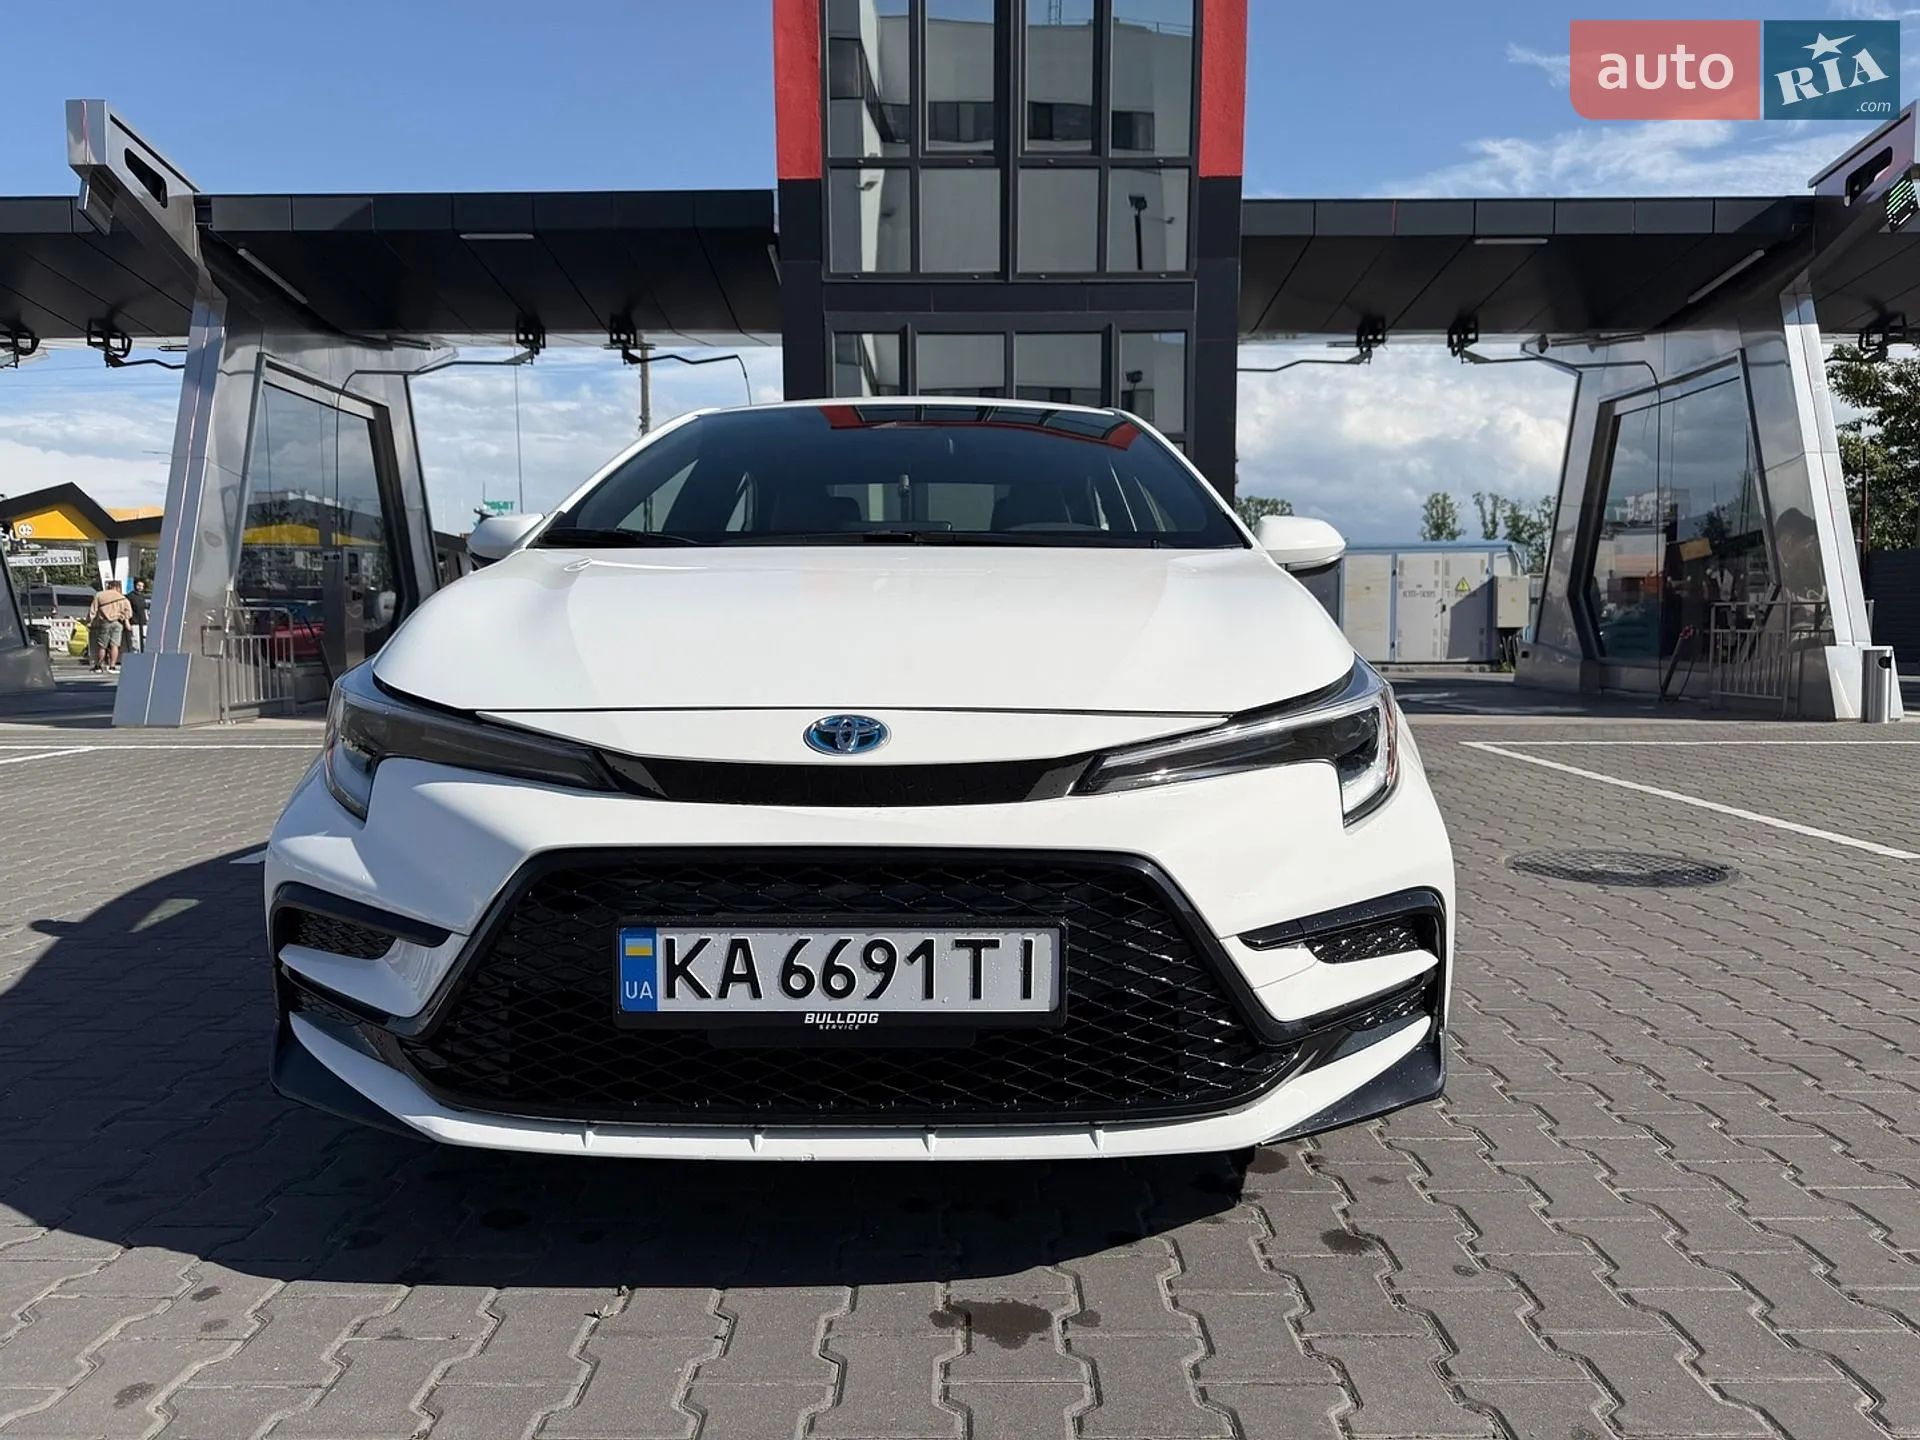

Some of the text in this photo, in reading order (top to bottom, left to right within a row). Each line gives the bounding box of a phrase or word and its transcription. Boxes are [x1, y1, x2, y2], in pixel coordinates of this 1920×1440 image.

[666, 938, 762, 999] KA
[781, 938, 935, 999] 6691
[625, 981, 653, 999] UA
[804, 1013, 879, 1024] BULLDOG
